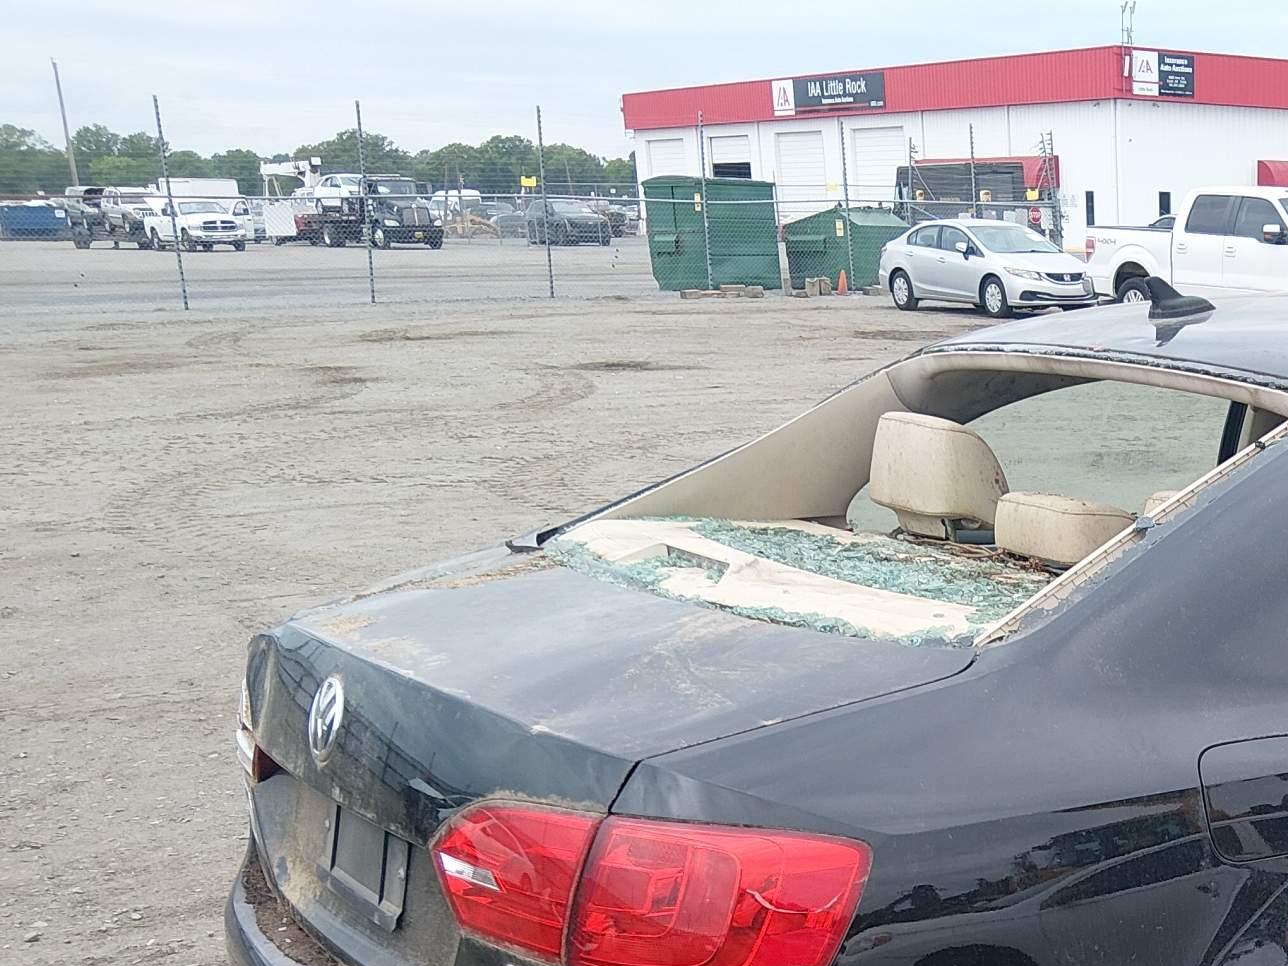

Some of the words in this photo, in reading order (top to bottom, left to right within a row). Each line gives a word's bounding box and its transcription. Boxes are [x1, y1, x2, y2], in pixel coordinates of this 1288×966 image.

[807, 81, 822, 96] IAA
[823, 80, 844, 96] Little
[845, 78, 867, 94] Rock
